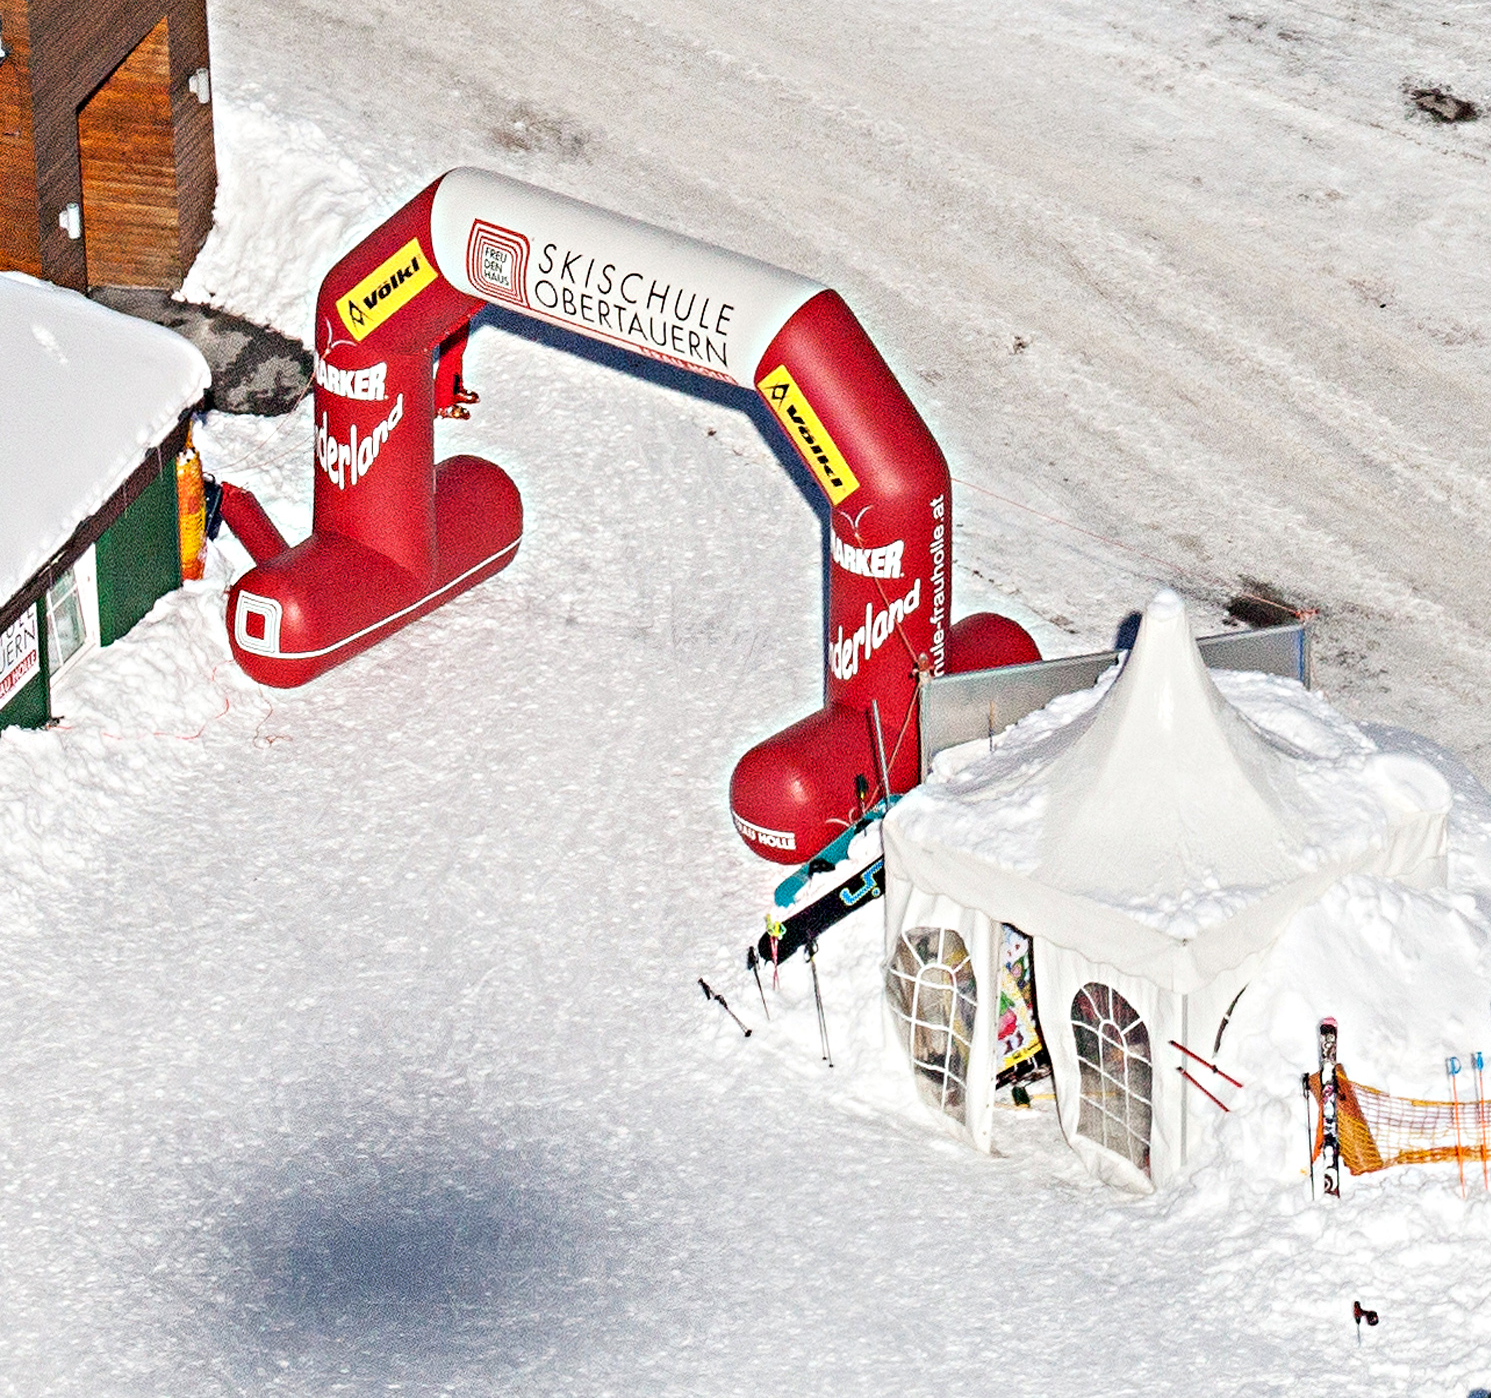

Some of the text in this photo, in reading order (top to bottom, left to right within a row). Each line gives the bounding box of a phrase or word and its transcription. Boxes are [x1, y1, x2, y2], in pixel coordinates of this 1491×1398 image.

[485, 246, 508, 264] FREU
[484, 258, 503, 274] DEN
[484, 269, 510, 286] HAUS
[538, 243, 735, 336] SKISCHULE
[534, 279, 729, 367] OBERTAUERN
